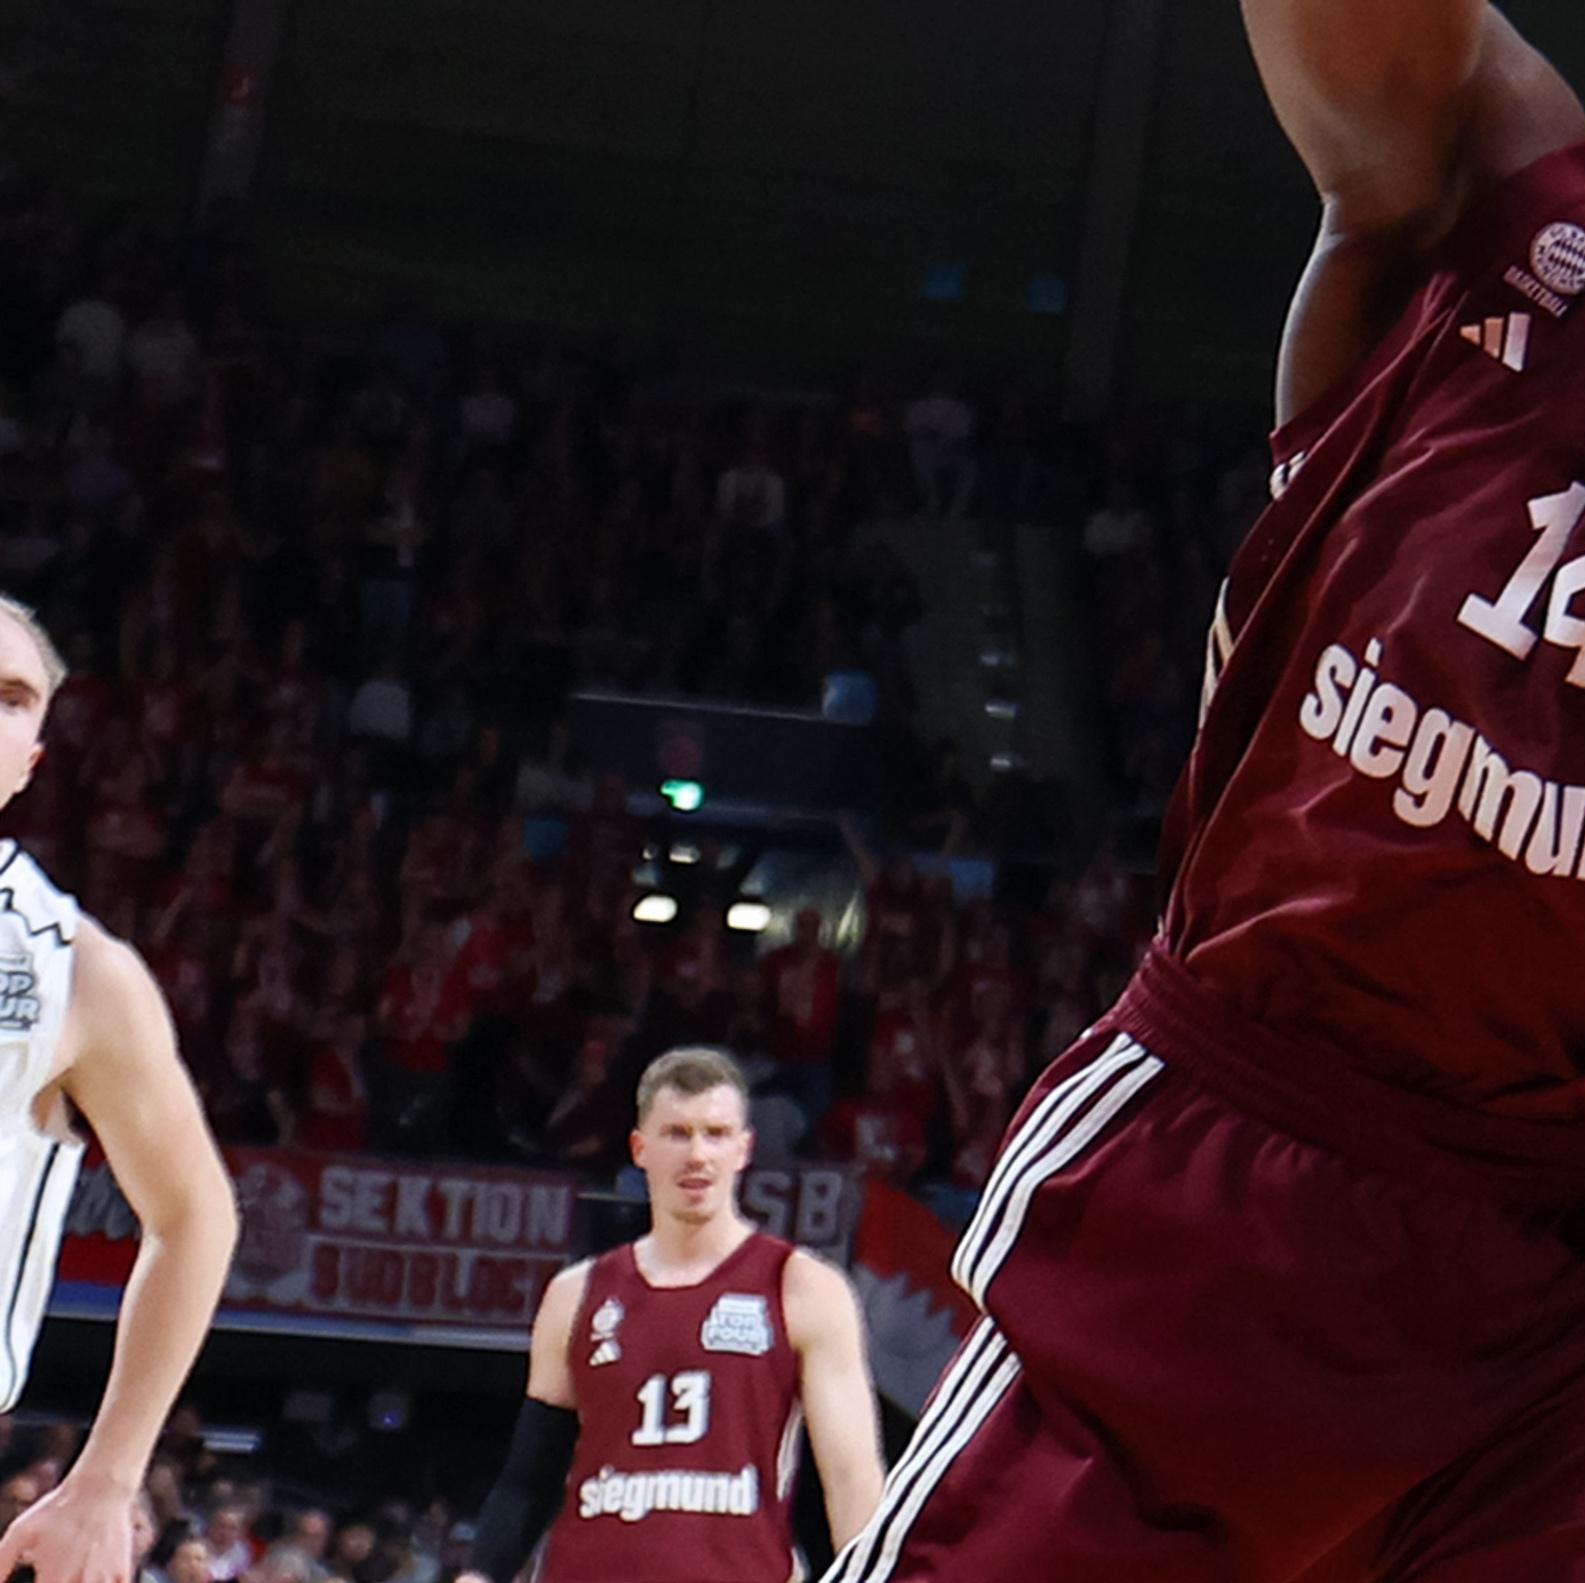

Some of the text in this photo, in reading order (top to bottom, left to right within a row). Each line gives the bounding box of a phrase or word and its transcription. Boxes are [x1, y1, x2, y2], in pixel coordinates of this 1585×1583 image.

[318, 1165, 570, 1244] SEKTION
[632, 1369, 711, 1446] 13
[579, 1462, 758, 1522] siegmund
